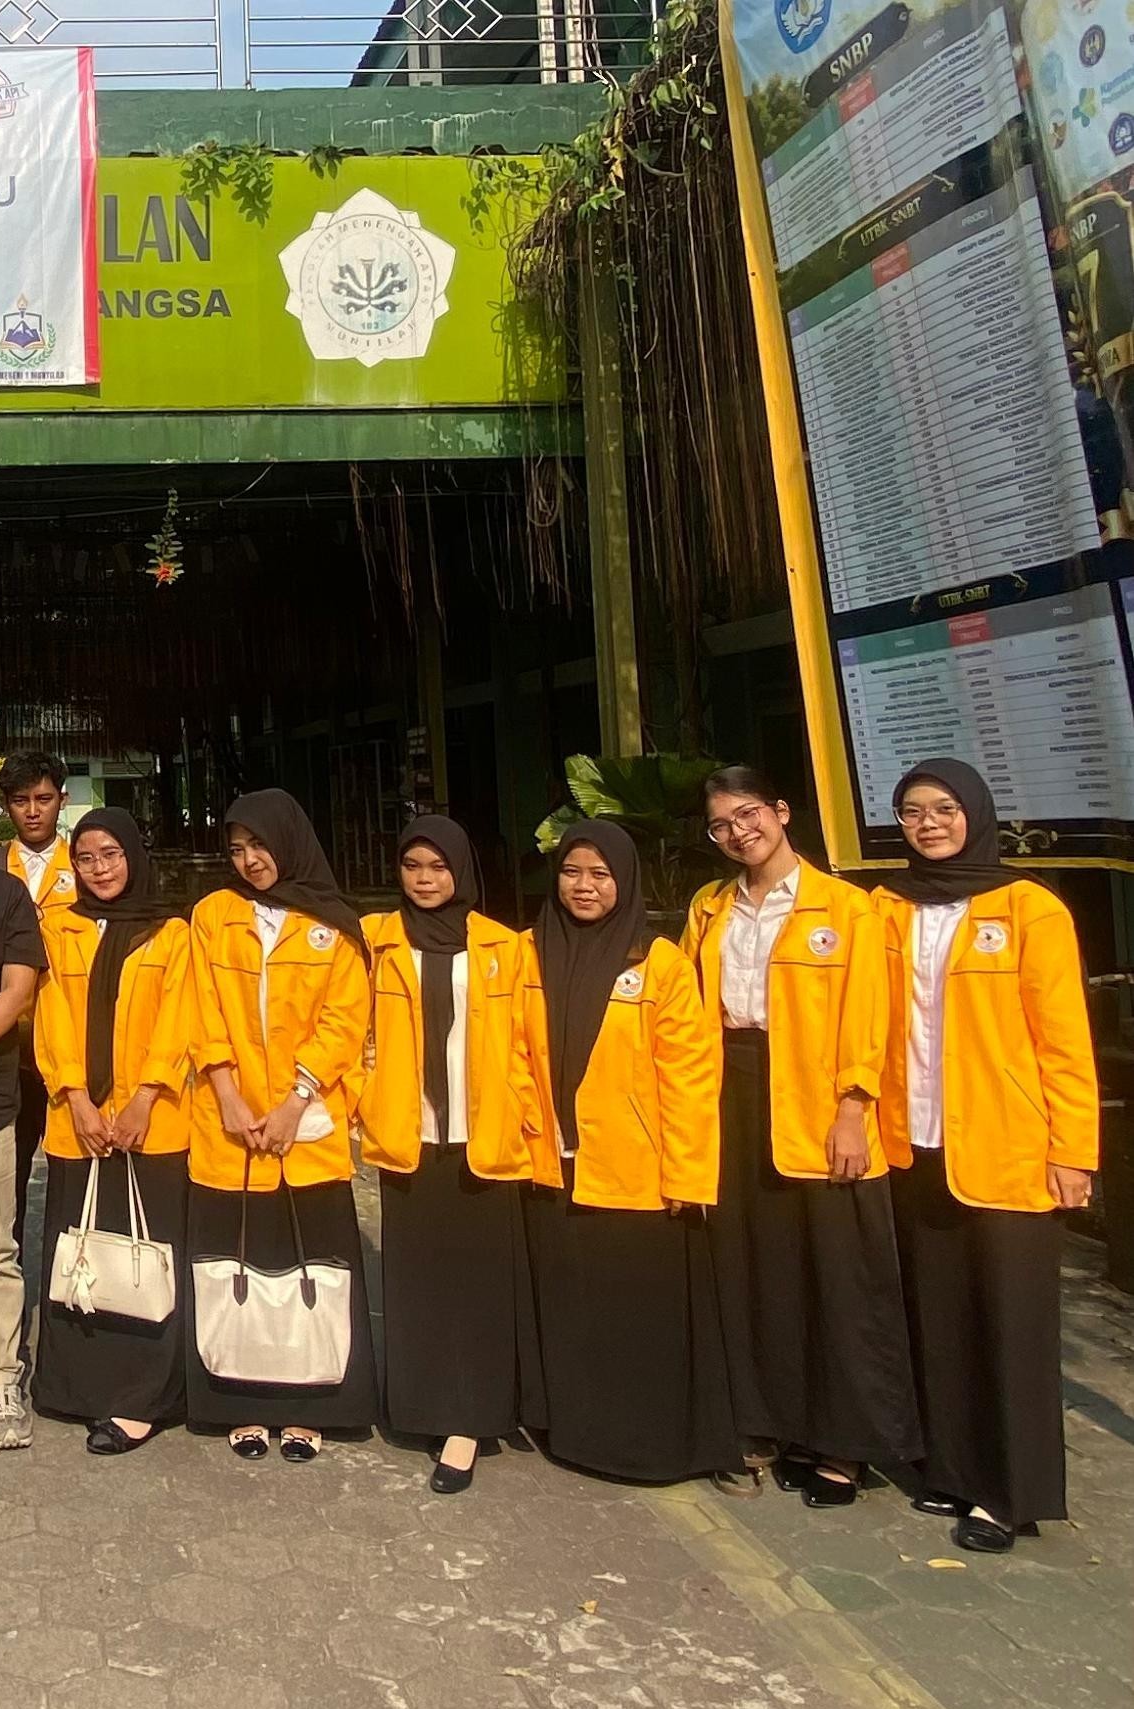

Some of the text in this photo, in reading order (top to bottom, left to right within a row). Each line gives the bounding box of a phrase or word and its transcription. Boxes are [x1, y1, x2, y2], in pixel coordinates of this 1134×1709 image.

[829, 32, 874, 83] SNBP
[5, 86, 20, 99] API
[337, 219, 422, 259] MENENGAH
[859, 196, 922, 247] UTBK-SNBT
